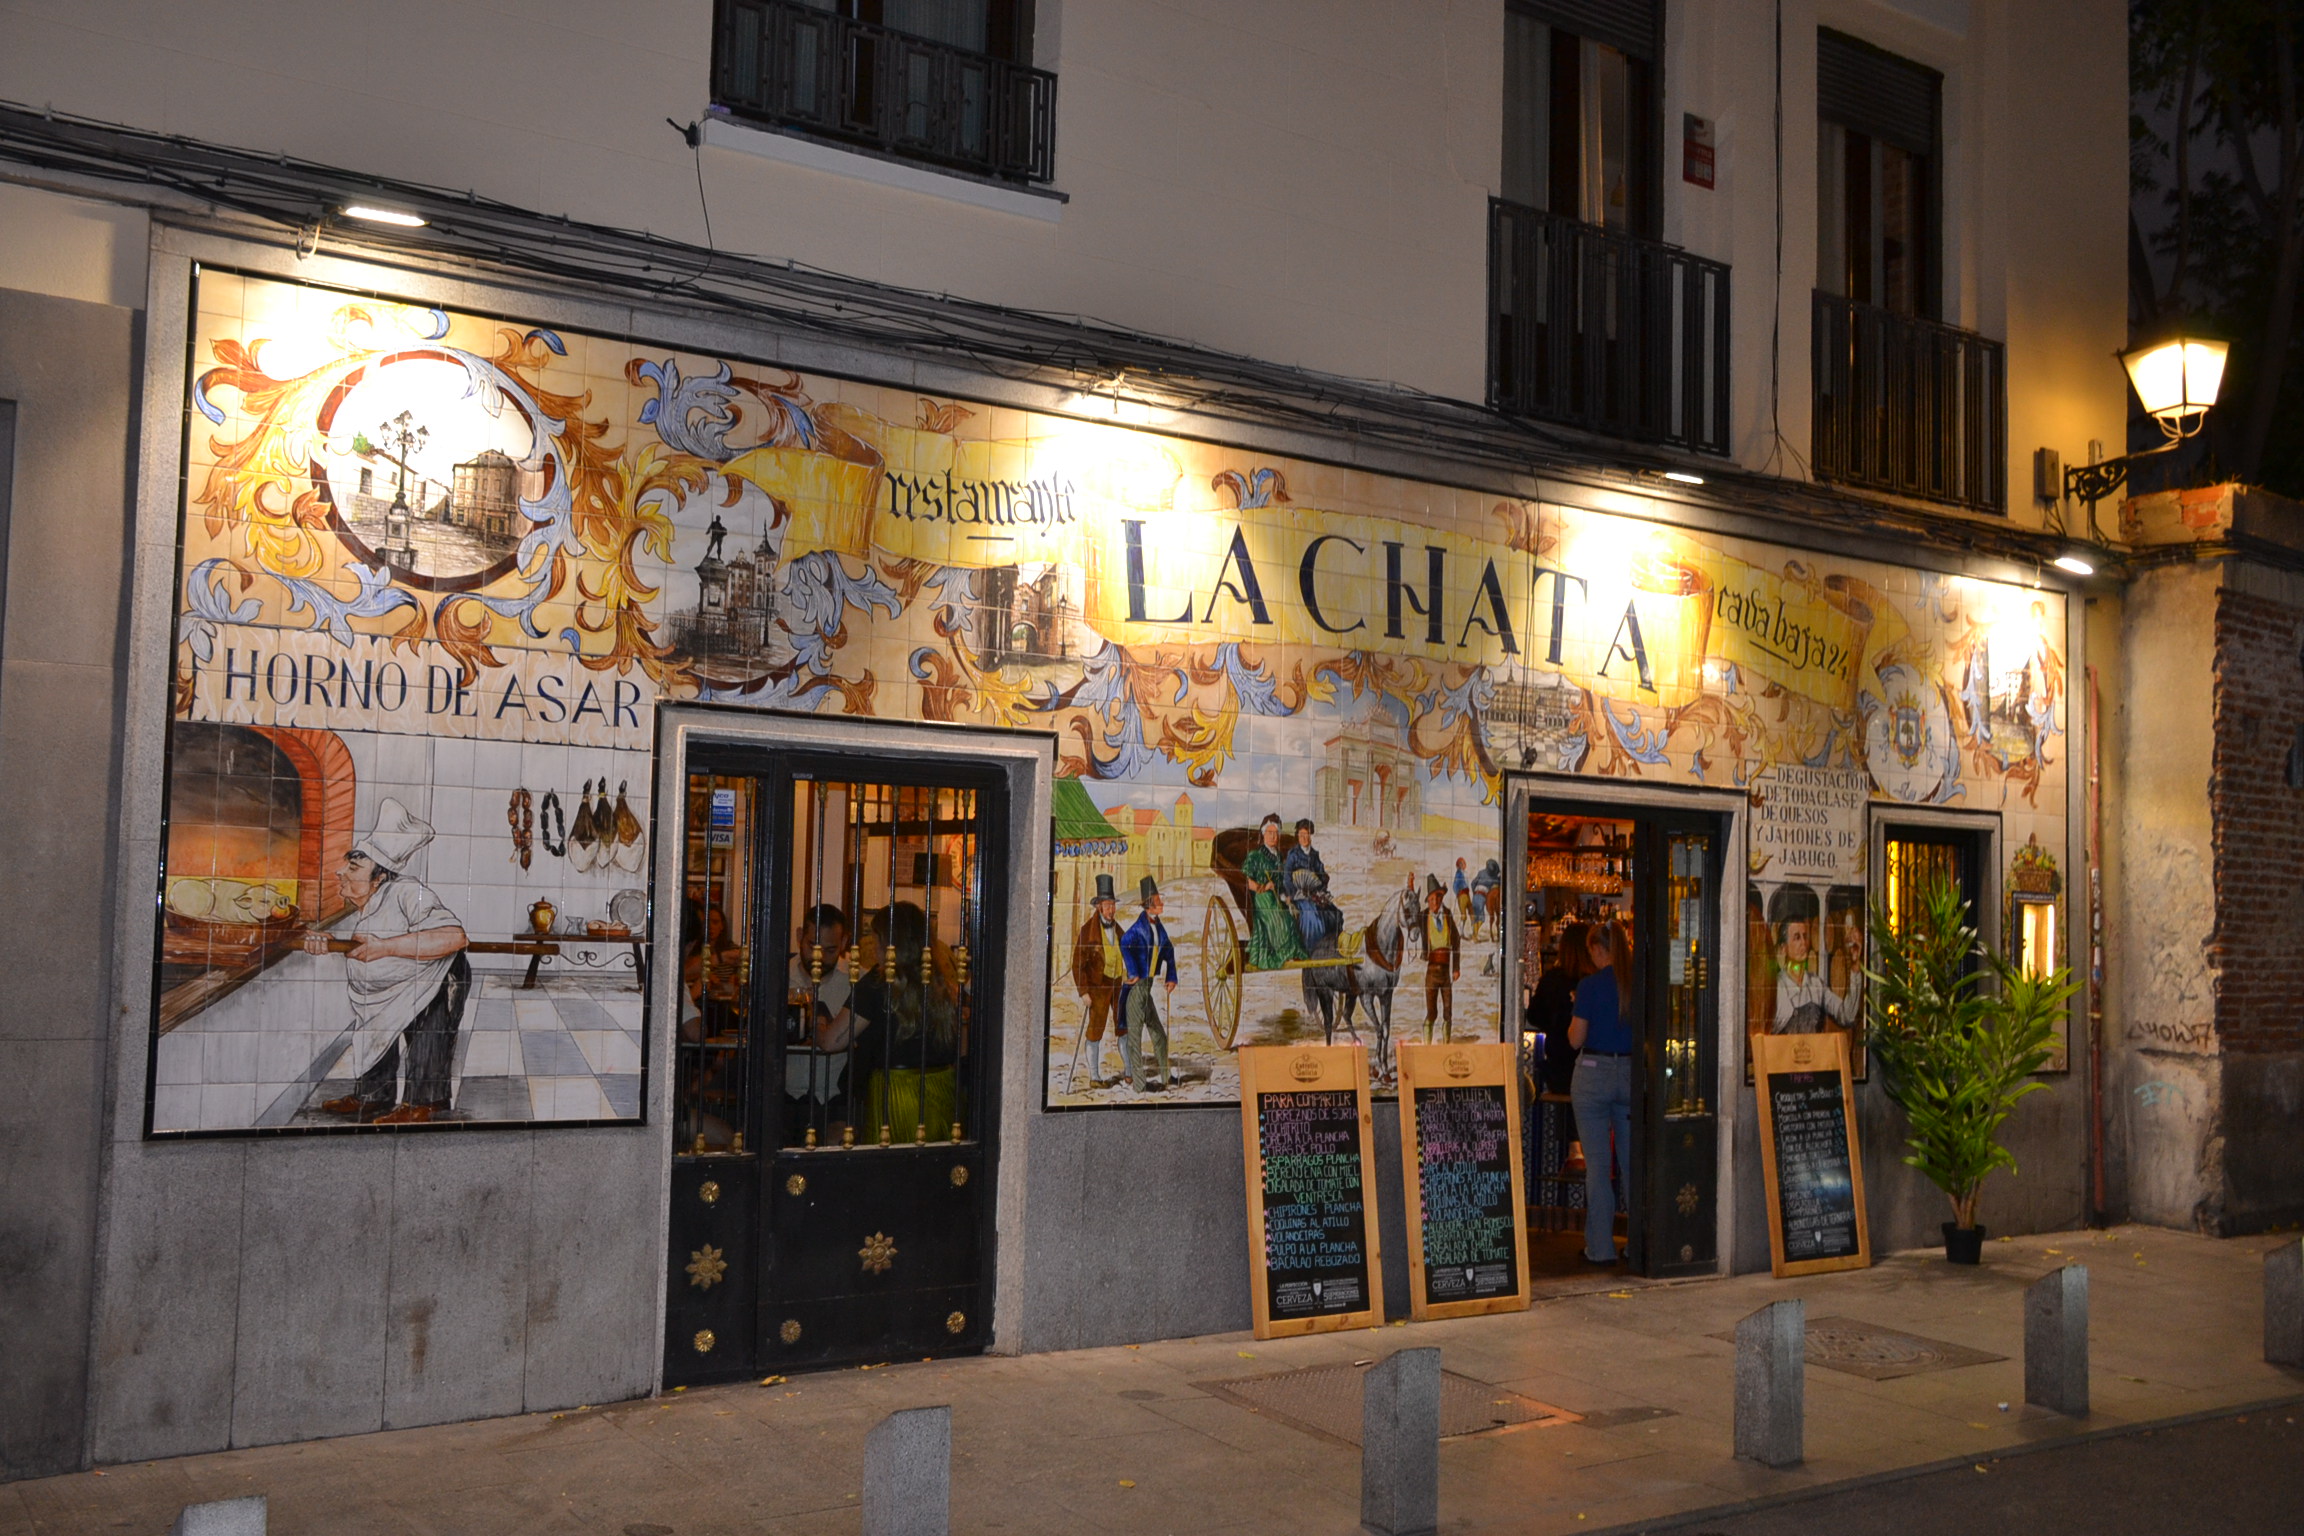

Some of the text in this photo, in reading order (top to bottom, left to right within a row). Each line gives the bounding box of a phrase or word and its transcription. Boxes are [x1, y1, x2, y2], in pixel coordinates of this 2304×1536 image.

[1121, 519, 1658, 693] LA CHATA
[225, 647, 641, 728] HORNO DE ASAR
[1764, 784, 1858, 809] DE TODA CLASE
[1761, 804, 1828, 825] DE QUESOS
[712, 834, 730, 843] VISA
[1755, 825, 1856, 848] Y JAMONES DE
[1264, 1091, 1351, 1109] PARA COMPARTIR
[1427, 1087, 1492, 1104] SIN GLUTEN
[1263, 1107, 1317, 1123] TORREZNOS
[1318, 1107, 1329, 1121] DE
[1302, 1134, 1313, 1145] LA
[1315, 1130, 1350, 1143] PLANCHA
[1266, 1143, 1336, 1157] TIRAS DE POLLO
[1265, 1153, 1360, 1169] ESPARRAGOS PLANCHA
[1266, 1165, 1360, 1181] BERENJENA CON MIEL
[1266, 1176, 1360, 1194] ENSALADA DE TOMATE CON
[1293, 1190, 1343, 1204] VENTRESCA
[1268, 1202, 1362, 1219] CHIPIRONES PLANCHA
[1269, 1217, 1306, 1231] COQUINAS
[1309, 1217, 1320, 1228] AL
[1270, 1229, 1325, 1242] VOLANDEIRAS
[1269, 1241, 1357, 1256] PULPO A LA PLANCHA
[1430, 1247, 1510, 1266] ENSALADA DE TOMATE
[1270, 1253, 1360, 1271] BACALAO REBOZADO
[1432, 1278, 1466, 1290] CERVEZA
[1276, 1293, 1313, 1305] CERVEZA
